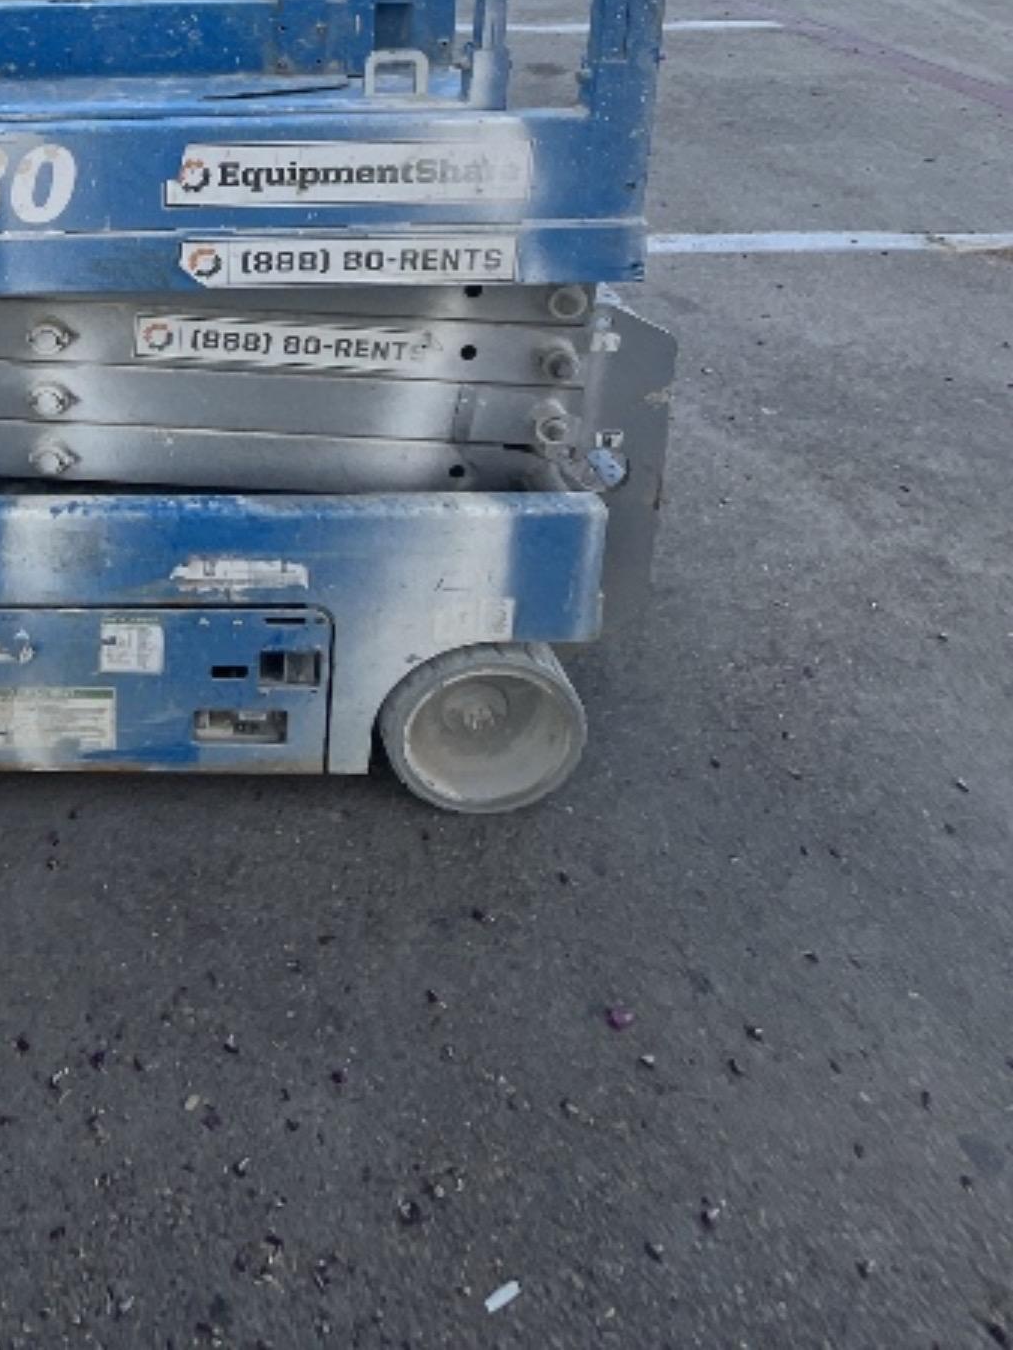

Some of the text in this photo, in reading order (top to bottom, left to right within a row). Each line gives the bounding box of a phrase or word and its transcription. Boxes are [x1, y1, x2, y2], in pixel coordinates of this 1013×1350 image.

[217, 158, 519, 192] EquipmentSha
[240, 247, 503, 275] (888) 80-RENTS
